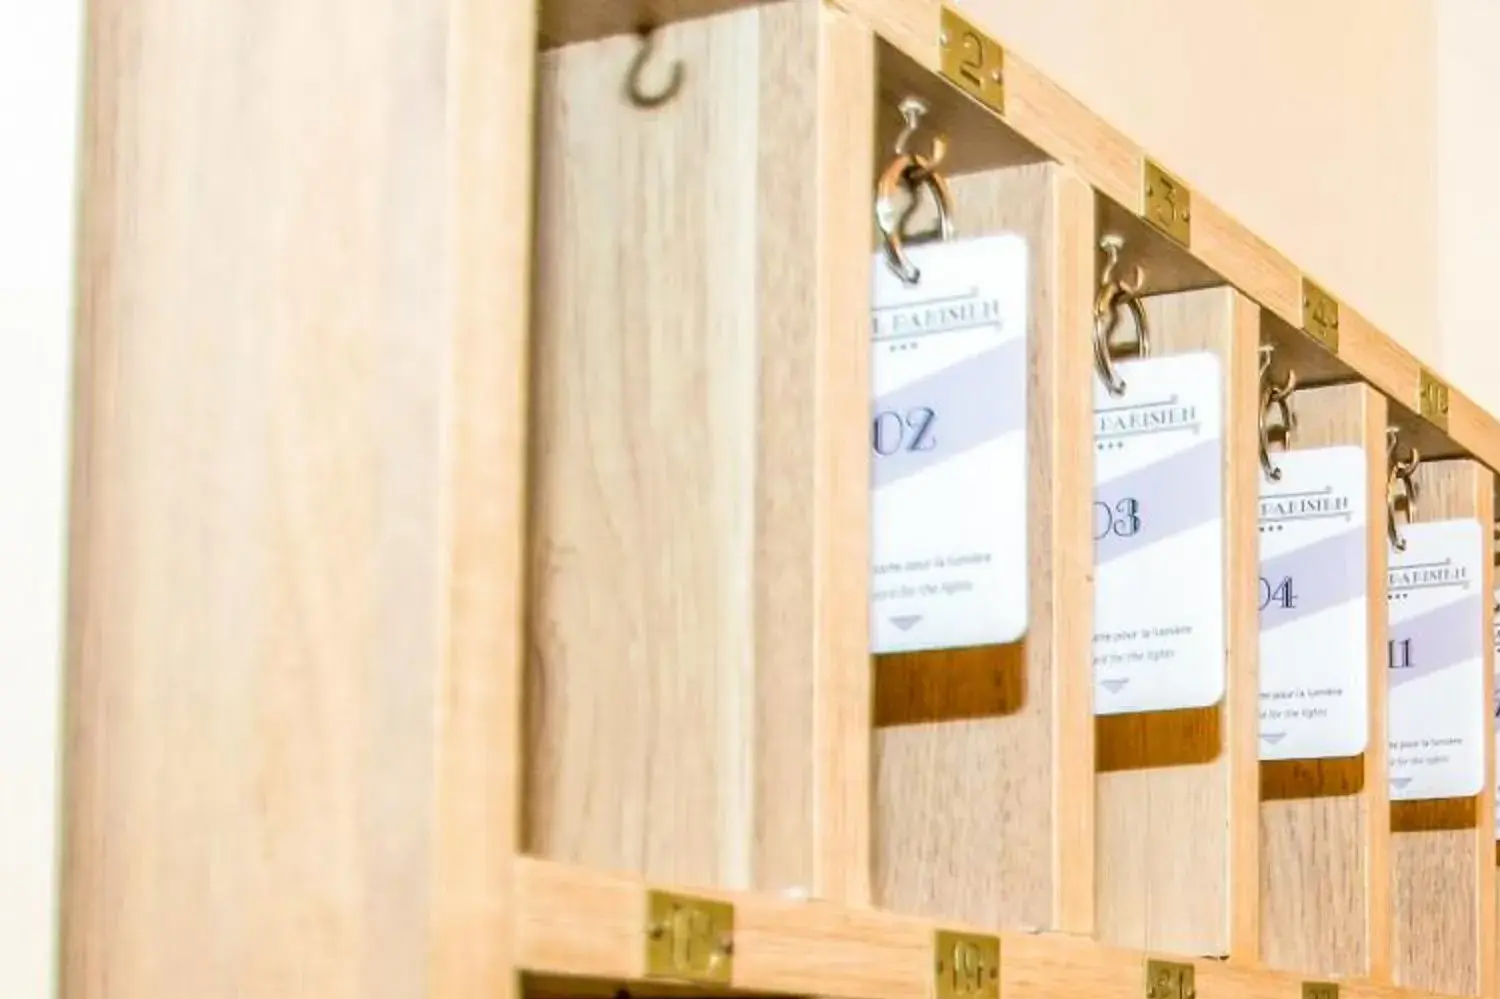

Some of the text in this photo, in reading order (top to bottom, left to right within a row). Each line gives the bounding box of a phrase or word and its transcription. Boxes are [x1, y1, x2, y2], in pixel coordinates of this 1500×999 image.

[958, 30, 986, 88] 2
[1158, 175, 1177, 228] 3
[872, 406, 938, 457] 02
